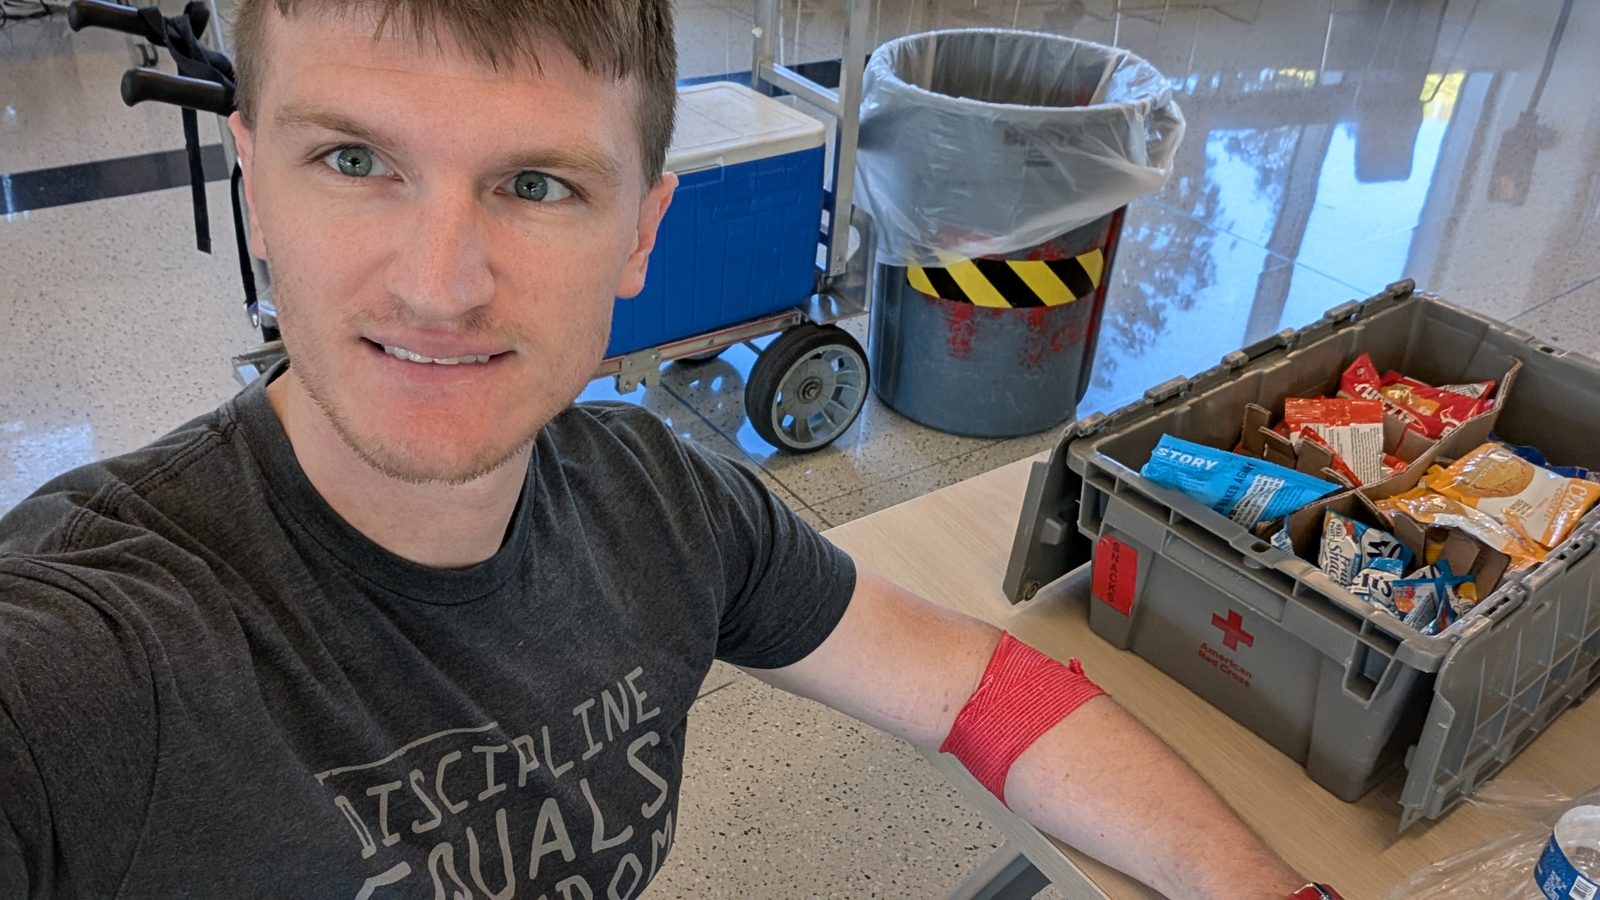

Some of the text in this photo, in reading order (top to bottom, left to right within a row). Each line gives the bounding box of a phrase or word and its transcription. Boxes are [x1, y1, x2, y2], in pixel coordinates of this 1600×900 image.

[1157, 447, 1219, 470] STORY
[1107, 542, 1120, 602] SNACKS
[1198, 649, 1250, 687] Red Cross
[1200, 643, 1252, 678] American
